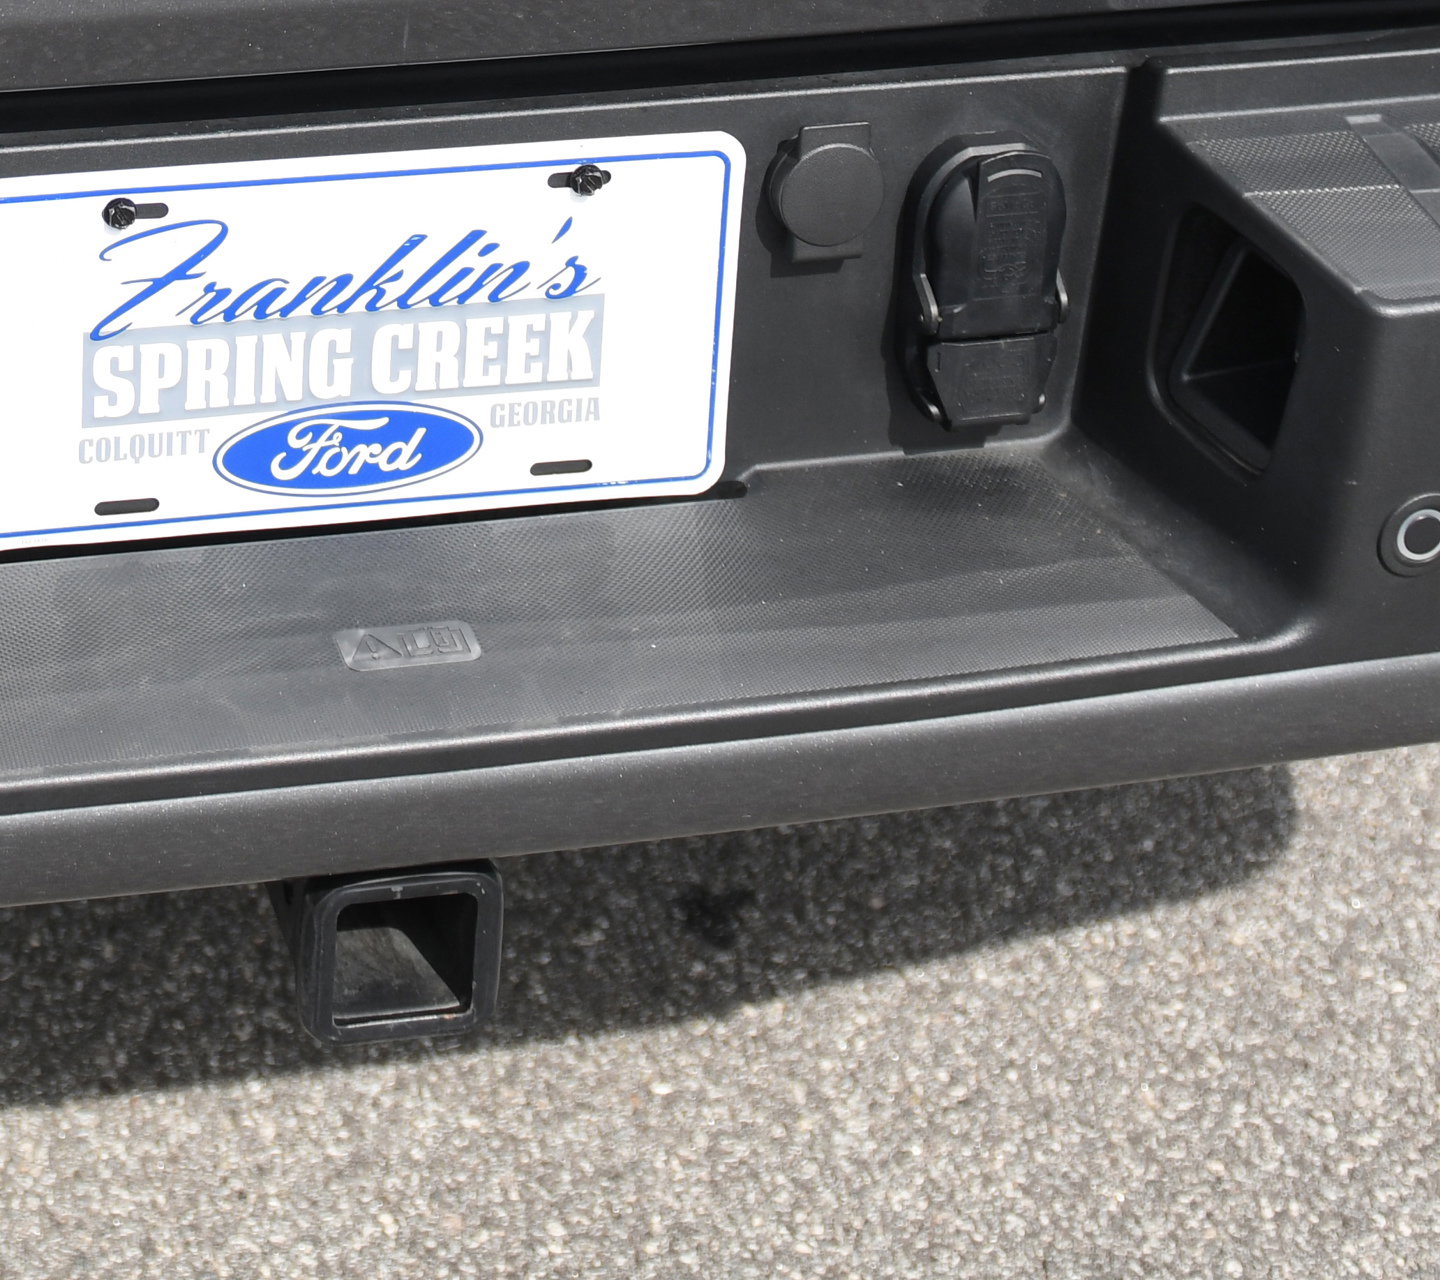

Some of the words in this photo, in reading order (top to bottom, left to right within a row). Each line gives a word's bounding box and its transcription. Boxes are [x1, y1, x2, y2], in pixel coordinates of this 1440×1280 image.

[88, 216, 602, 341] Franklin's
[91, 325, 355, 421] SPRING
[369, 308, 595, 397] CREEK
[489, 395, 602, 430] GEORGIA
[77, 427, 212, 466] COLQUITT
[270, 415, 424, 482] Ford
